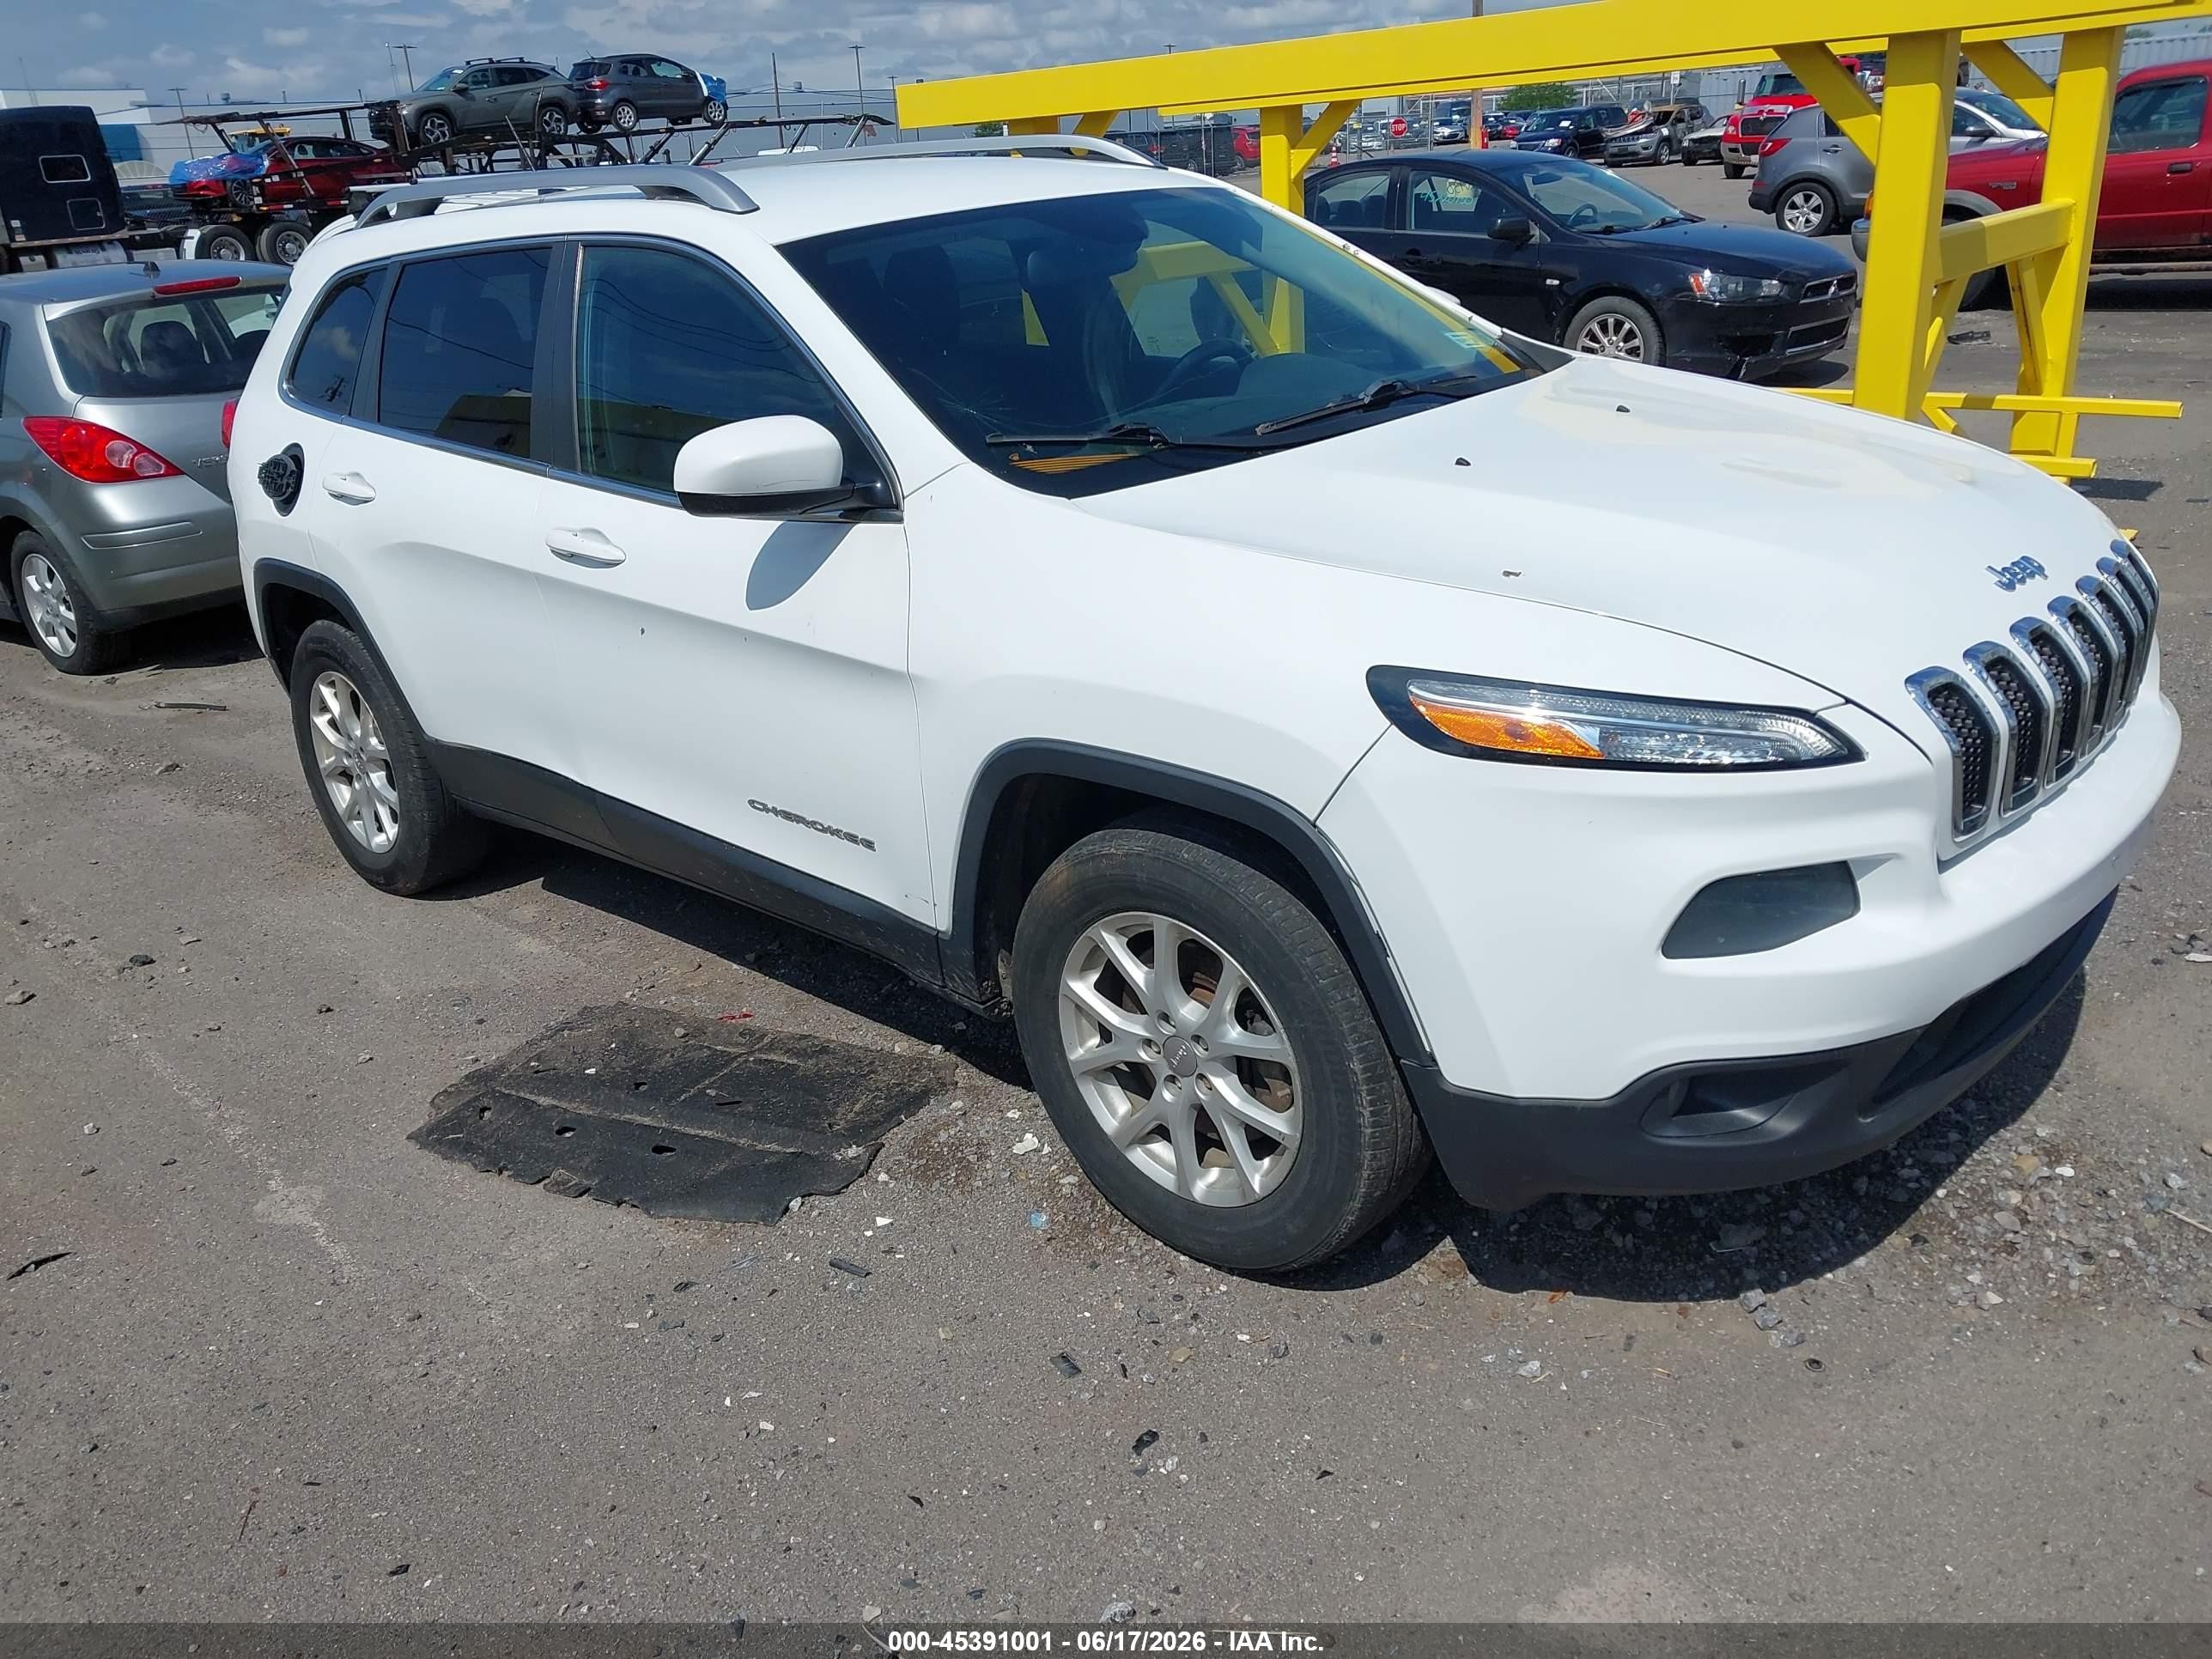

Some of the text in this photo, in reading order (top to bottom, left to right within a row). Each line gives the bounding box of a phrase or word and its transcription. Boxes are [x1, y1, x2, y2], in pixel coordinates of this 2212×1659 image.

[1391, 123, 1407, 132] STOP
[1984, 555, 2049, 592] Jeep
[747, 799, 877, 853] CHEROKEE
